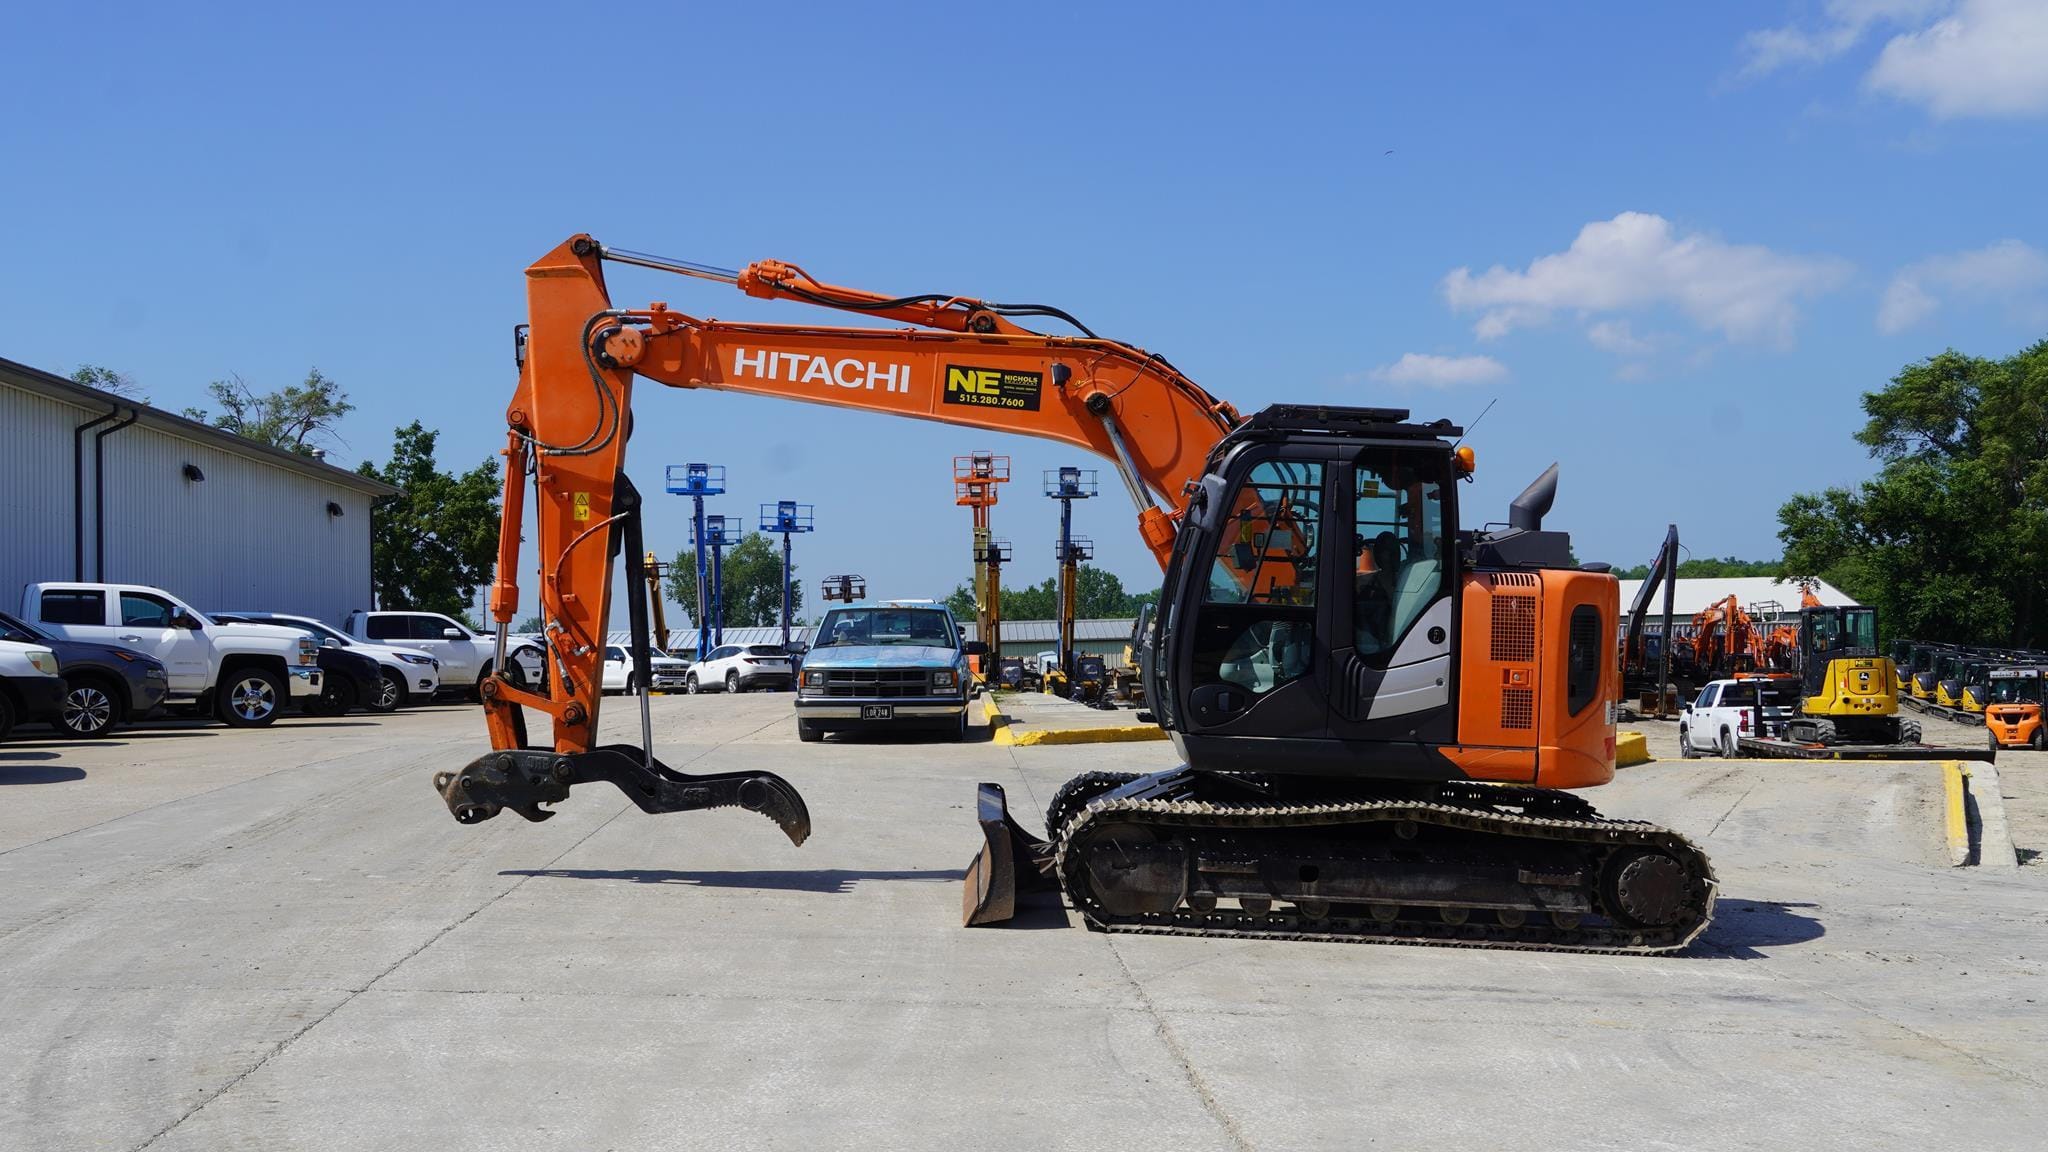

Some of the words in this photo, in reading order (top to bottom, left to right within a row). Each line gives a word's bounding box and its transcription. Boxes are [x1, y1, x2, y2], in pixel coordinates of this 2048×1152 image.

[733, 348, 911, 393] HITACHI
[1004, 374, 1038, 383] NICHOLS
[948, 368, 1002, 395] NE
[959, 394, 1025, 407] 515.280.7600
